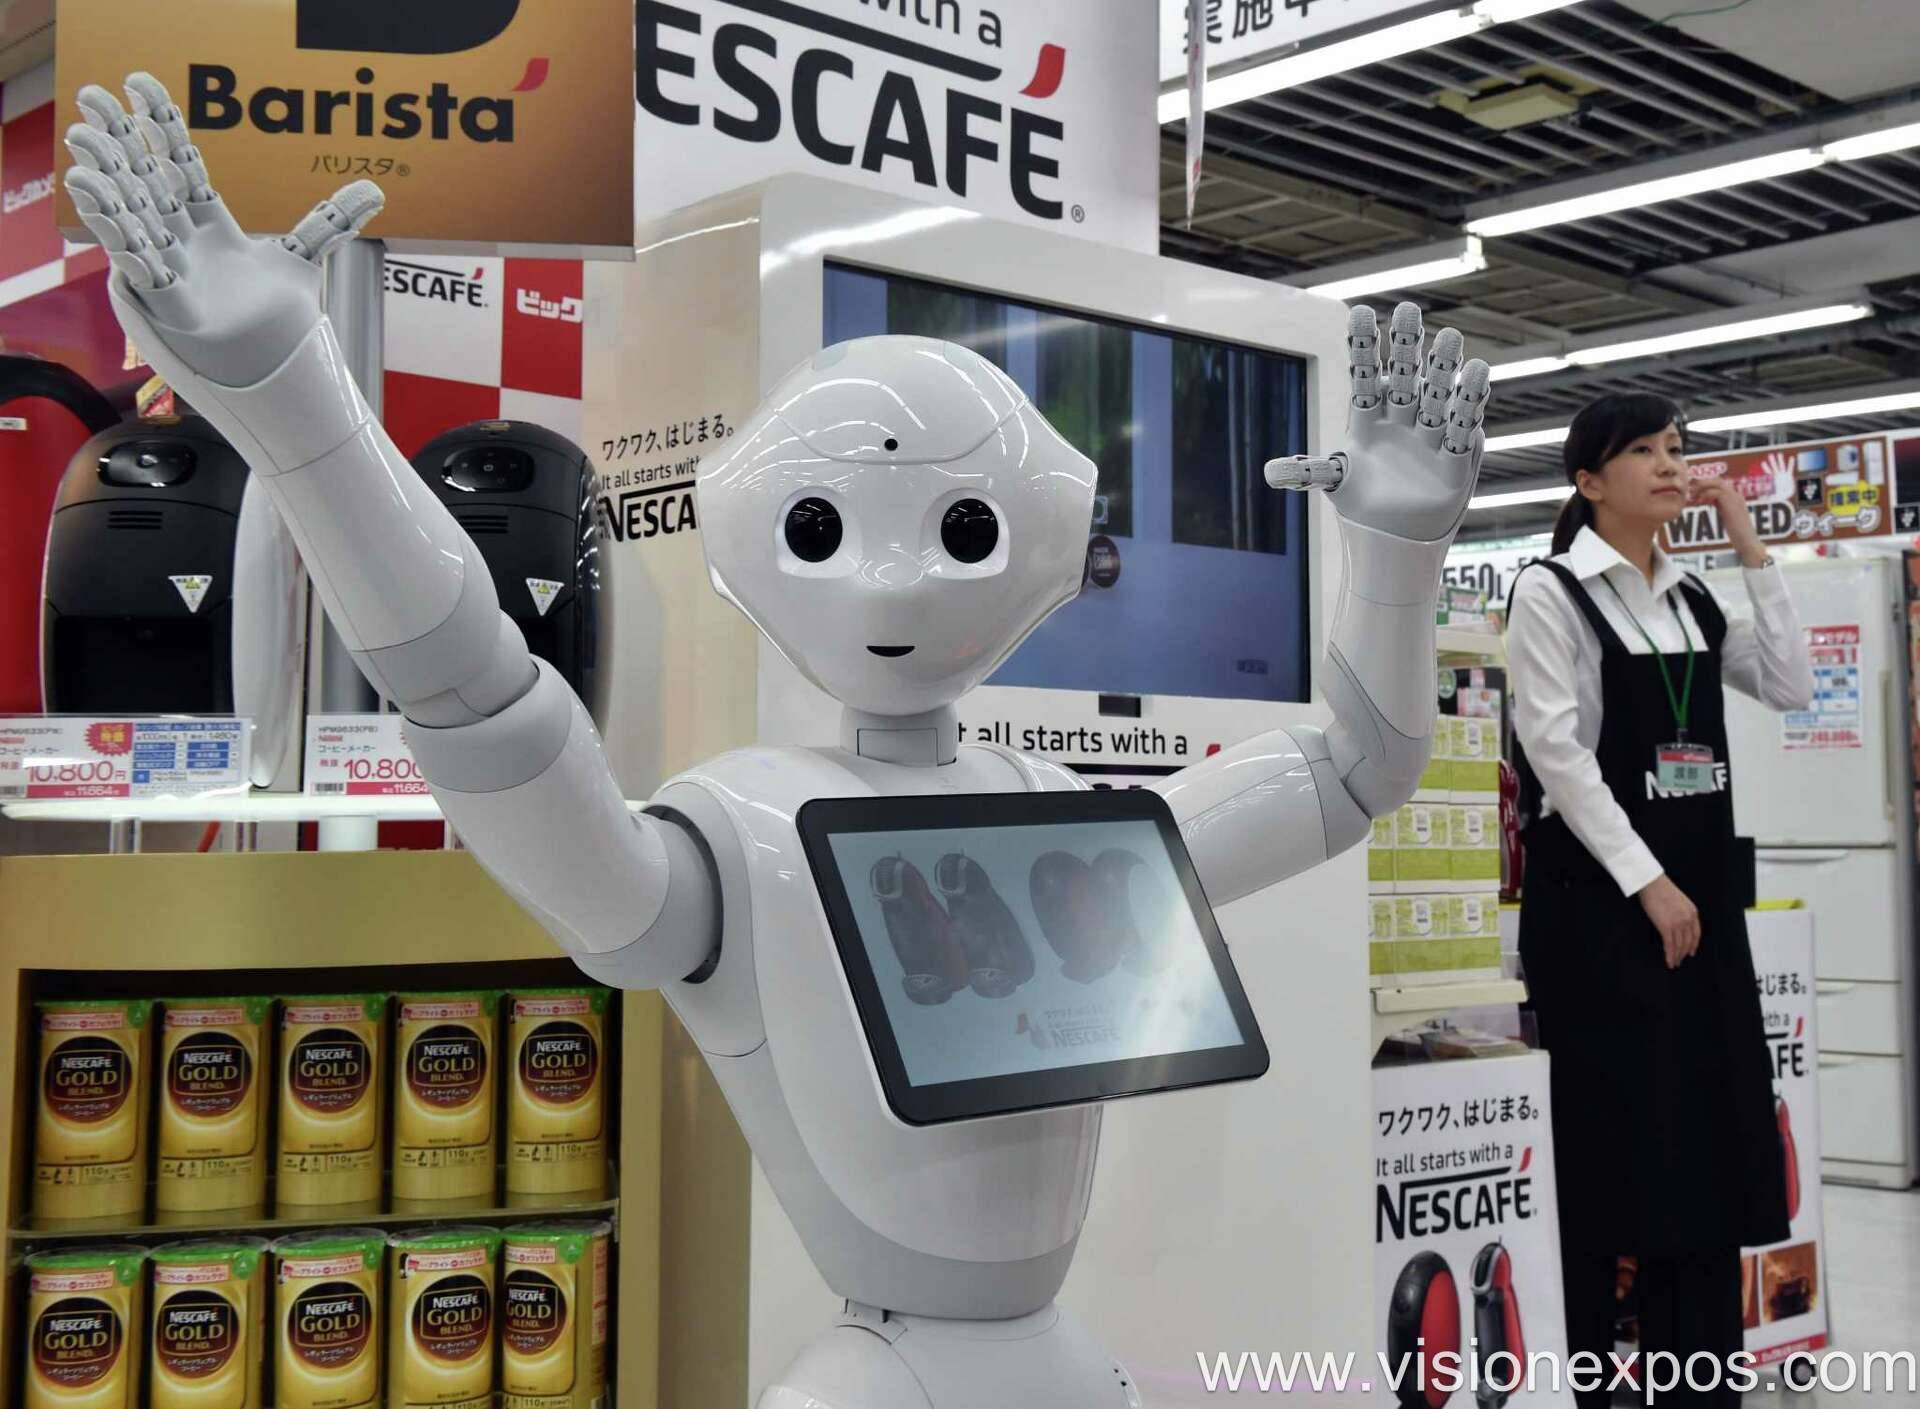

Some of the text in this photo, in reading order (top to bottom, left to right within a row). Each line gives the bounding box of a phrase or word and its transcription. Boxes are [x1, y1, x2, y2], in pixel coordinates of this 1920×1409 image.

[978, 9, 1002, 48] a
[188, 64, 514, 142] Barista
[602, 413, 735, 462] ワクワク、はじまる。
[614, 469, 631, 488] all
[634, 462, 672, 484] starts
[1022, 725, 1103, 752] starts
[1110, 727, 1166, 755] with
[1174, 735, 1188, 755] a
[300, 1062, 359, 1078] GOLD
[418, 1056, 476, 1074] GOLD
[531, 1053, 587, 1070] GOLD
[55, 1069, 118, 1087] GOLD
[179, 1064, 238, 1081] GOLD
[1379, 1095, 1539, 1136] ワクワク、はじまる。
[1377, 1142, 1513, 1177] It all starts with a
[300, 1313, 361, 1333] GOLD
[427, 1306, 483, 1326] GOLD
[44, 1331, 109, 1350] GOLD
[165, 1323, 225, 1341] GOLD
